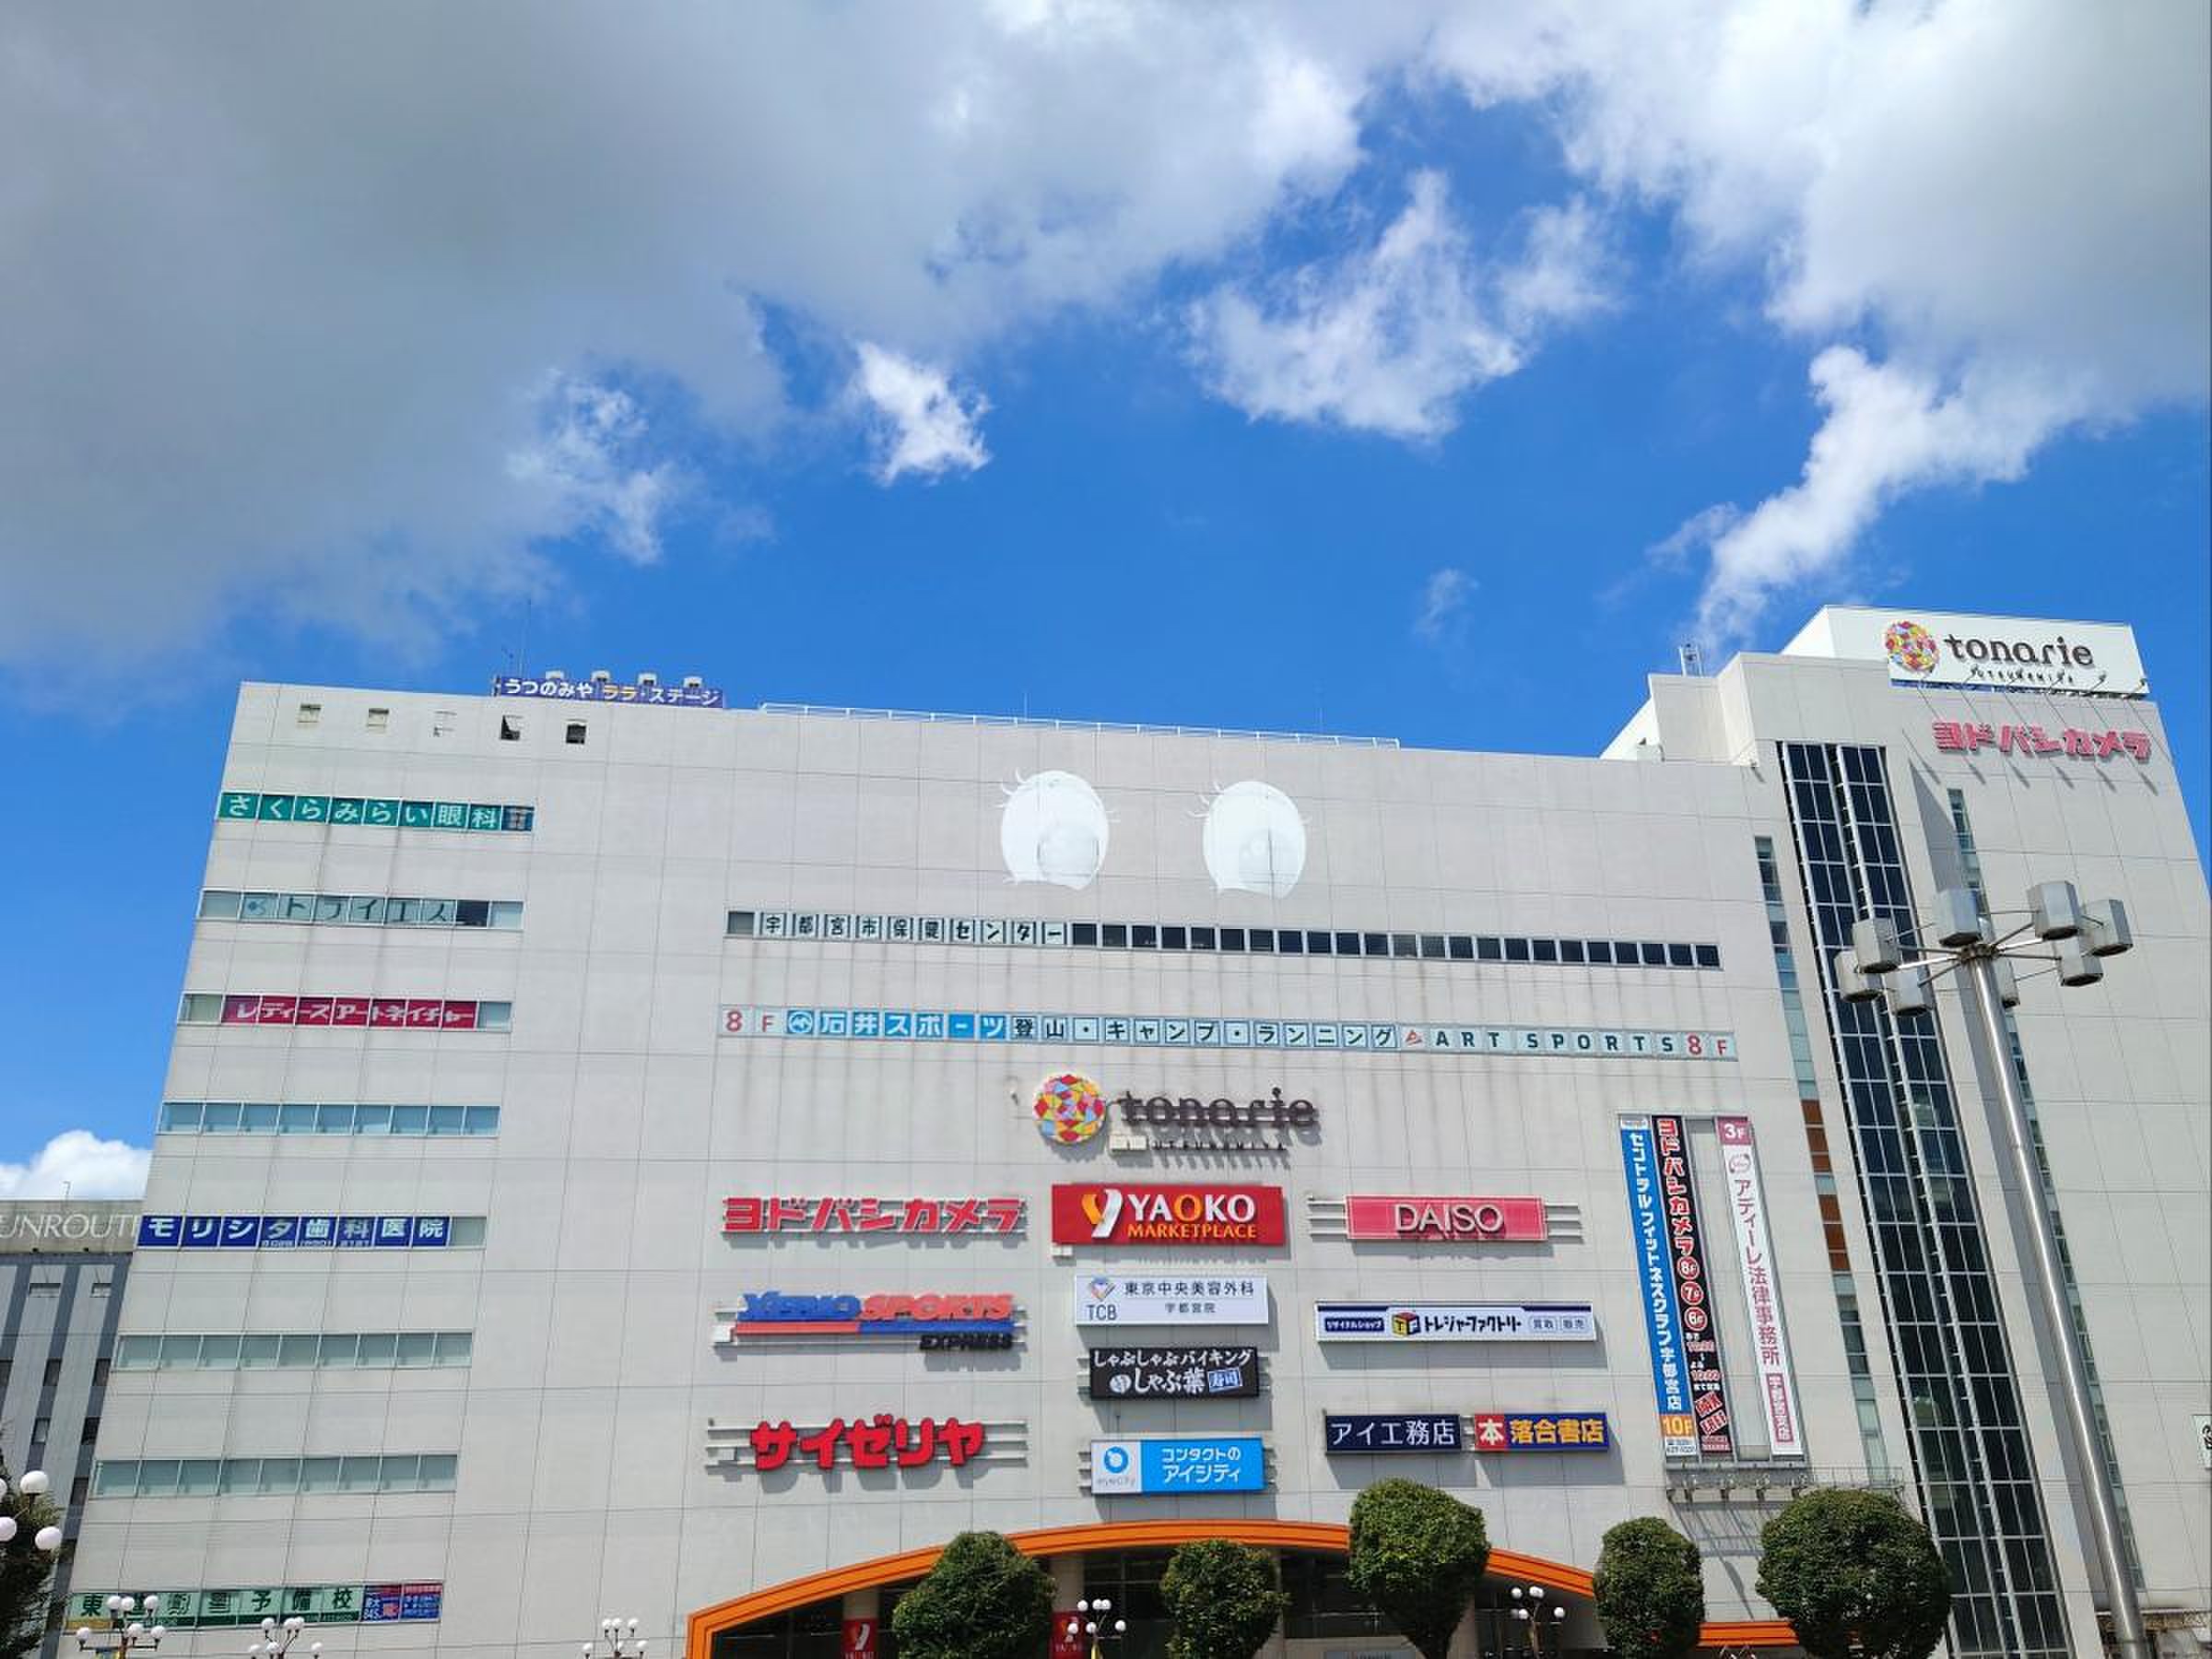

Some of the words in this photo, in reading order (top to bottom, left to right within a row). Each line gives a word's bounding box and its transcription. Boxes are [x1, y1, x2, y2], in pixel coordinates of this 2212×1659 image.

[1944, 634, 2094, 666] tonarie
[505, 678, 593, 698] うつのみや
[1933, 722, 2151, 759] ヨドバシカメラ
[229, 795, 498, 828] さくらみらい眼科
[766, 916, 1064, 943] 宇都宮市保健センター
[236, 1002, 475, 1023] レディースアートネイチャー
[821, 1013, 1006, 1038] 石井スポーツ
[1526, 1032, 1674, 1053] SPORTS
[1118, 1088, 1318, 1128] tonarie
[1724, 1124, 1746, 1139] 3F
[1657, 1119, 1694, 1256] ヨドバシカメラ
[724, 1197, 1023, 1231] ヨドバシカメラ
[1127, 1193, 1256, 1223] YAOKO
[1394, 1203, 1505, 1234] DAISO
[148, 1218, 444, 1240] モリシタ歯科医院
[1127, 1224, 1257, 1240] MARKETPLACE
[1734, 1179, 1780, 1365] アディーレ法律事務所
[1124, 1280, 1254, 1297] 東京中央美容外科
[1087, 1304, 1118, 1322] TCB
[1424, 1316, 1522, 1333] トレジャーファクトリー
[1094, 1349, 1253, 1368] しゃぶしゃぶバイキング
[1134, 1368, 1206, 1394] しゃぶ葉
[750, 1413, 985, 1471] サイゼリヤ
[1330, 1420, 1455, 1445] アイ工務店
[1477, 1418, 1504, 1446] 本
[1509, 1418, 1604, 1443] 落合書店
[1161, 1446, 1241, 1462] コンタクトの
[1162, 1464, 1241, 1483] アイシティ
